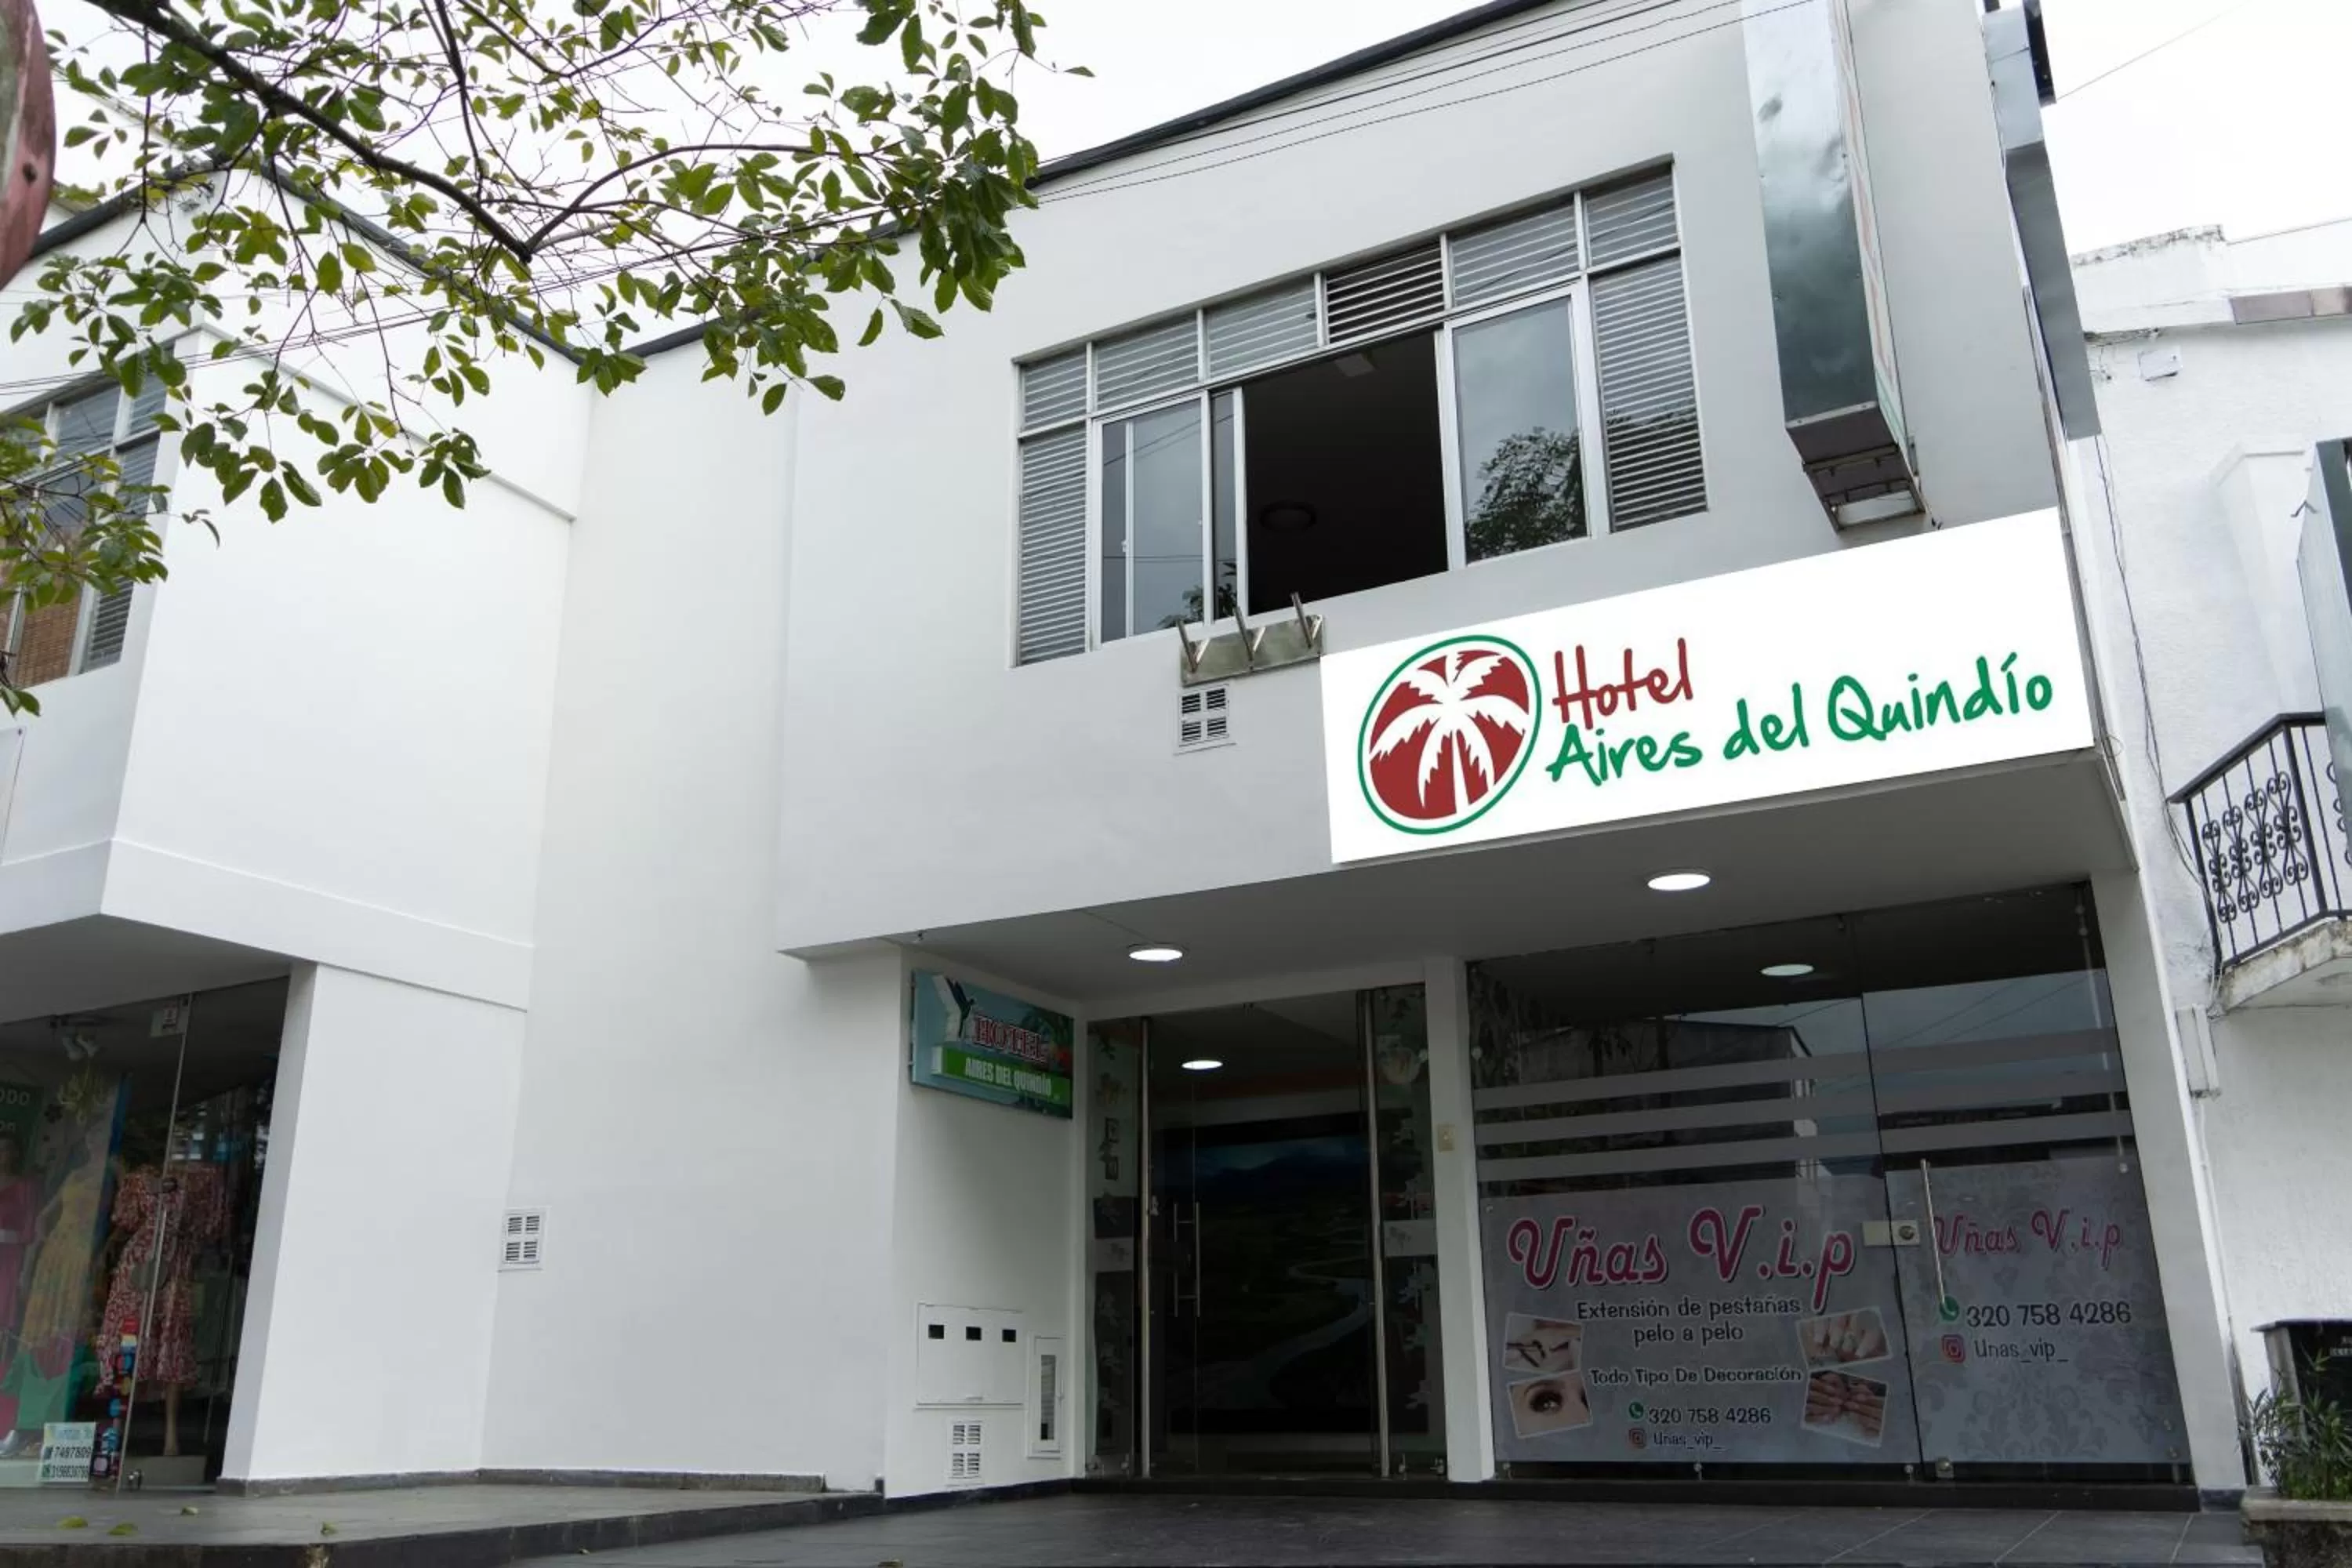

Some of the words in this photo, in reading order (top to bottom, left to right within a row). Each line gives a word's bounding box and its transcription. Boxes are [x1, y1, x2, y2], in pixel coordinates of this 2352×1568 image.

[1552, 638, 1695, 731] Hotel
[1544, 723, 1703, 787] Aires
[1723, 683, 1809, 760] del
[1827, 652, 2054, 742] Quindío
[964, 1056, 995, 1083] AIRES
[995, 1063, 1012, 1087] DEL
[1932, 1214, 2022, 1254] Uñas
[1506, 1215, 1669, 1290] Uñas
[1687, 1204, 1856, 1315] V.i.p
[1577, 1299, 1670, 1319] Extensión
[1677, 1298, 1702, 1316] de
[1709, 1297, 1801, 1320] pestañas
[1966, 1305, 2010, 1328] 320
[2016, 1302, 2060, 1326] 758
[2068, 1300, 2132, 1325] 4286
[1633, 1323, 1675, 1347] pelo
[1682, 1328, 1695, 1341] a
[1701, 1320, 1744, 1345] pelo
[1590, 1369, 1630, 1385] Todo
[1635, 1369, 1670, 1388] Tipo
[1675, 1368, 1698, 1384] De
[1703, 1365, 1802, 1382] Decoración
[1648, 1409, 1683, 1425] 320
[1687, 1409, 1721, 1424] 758
[1725, 1407, 1772, 1425] 4286
